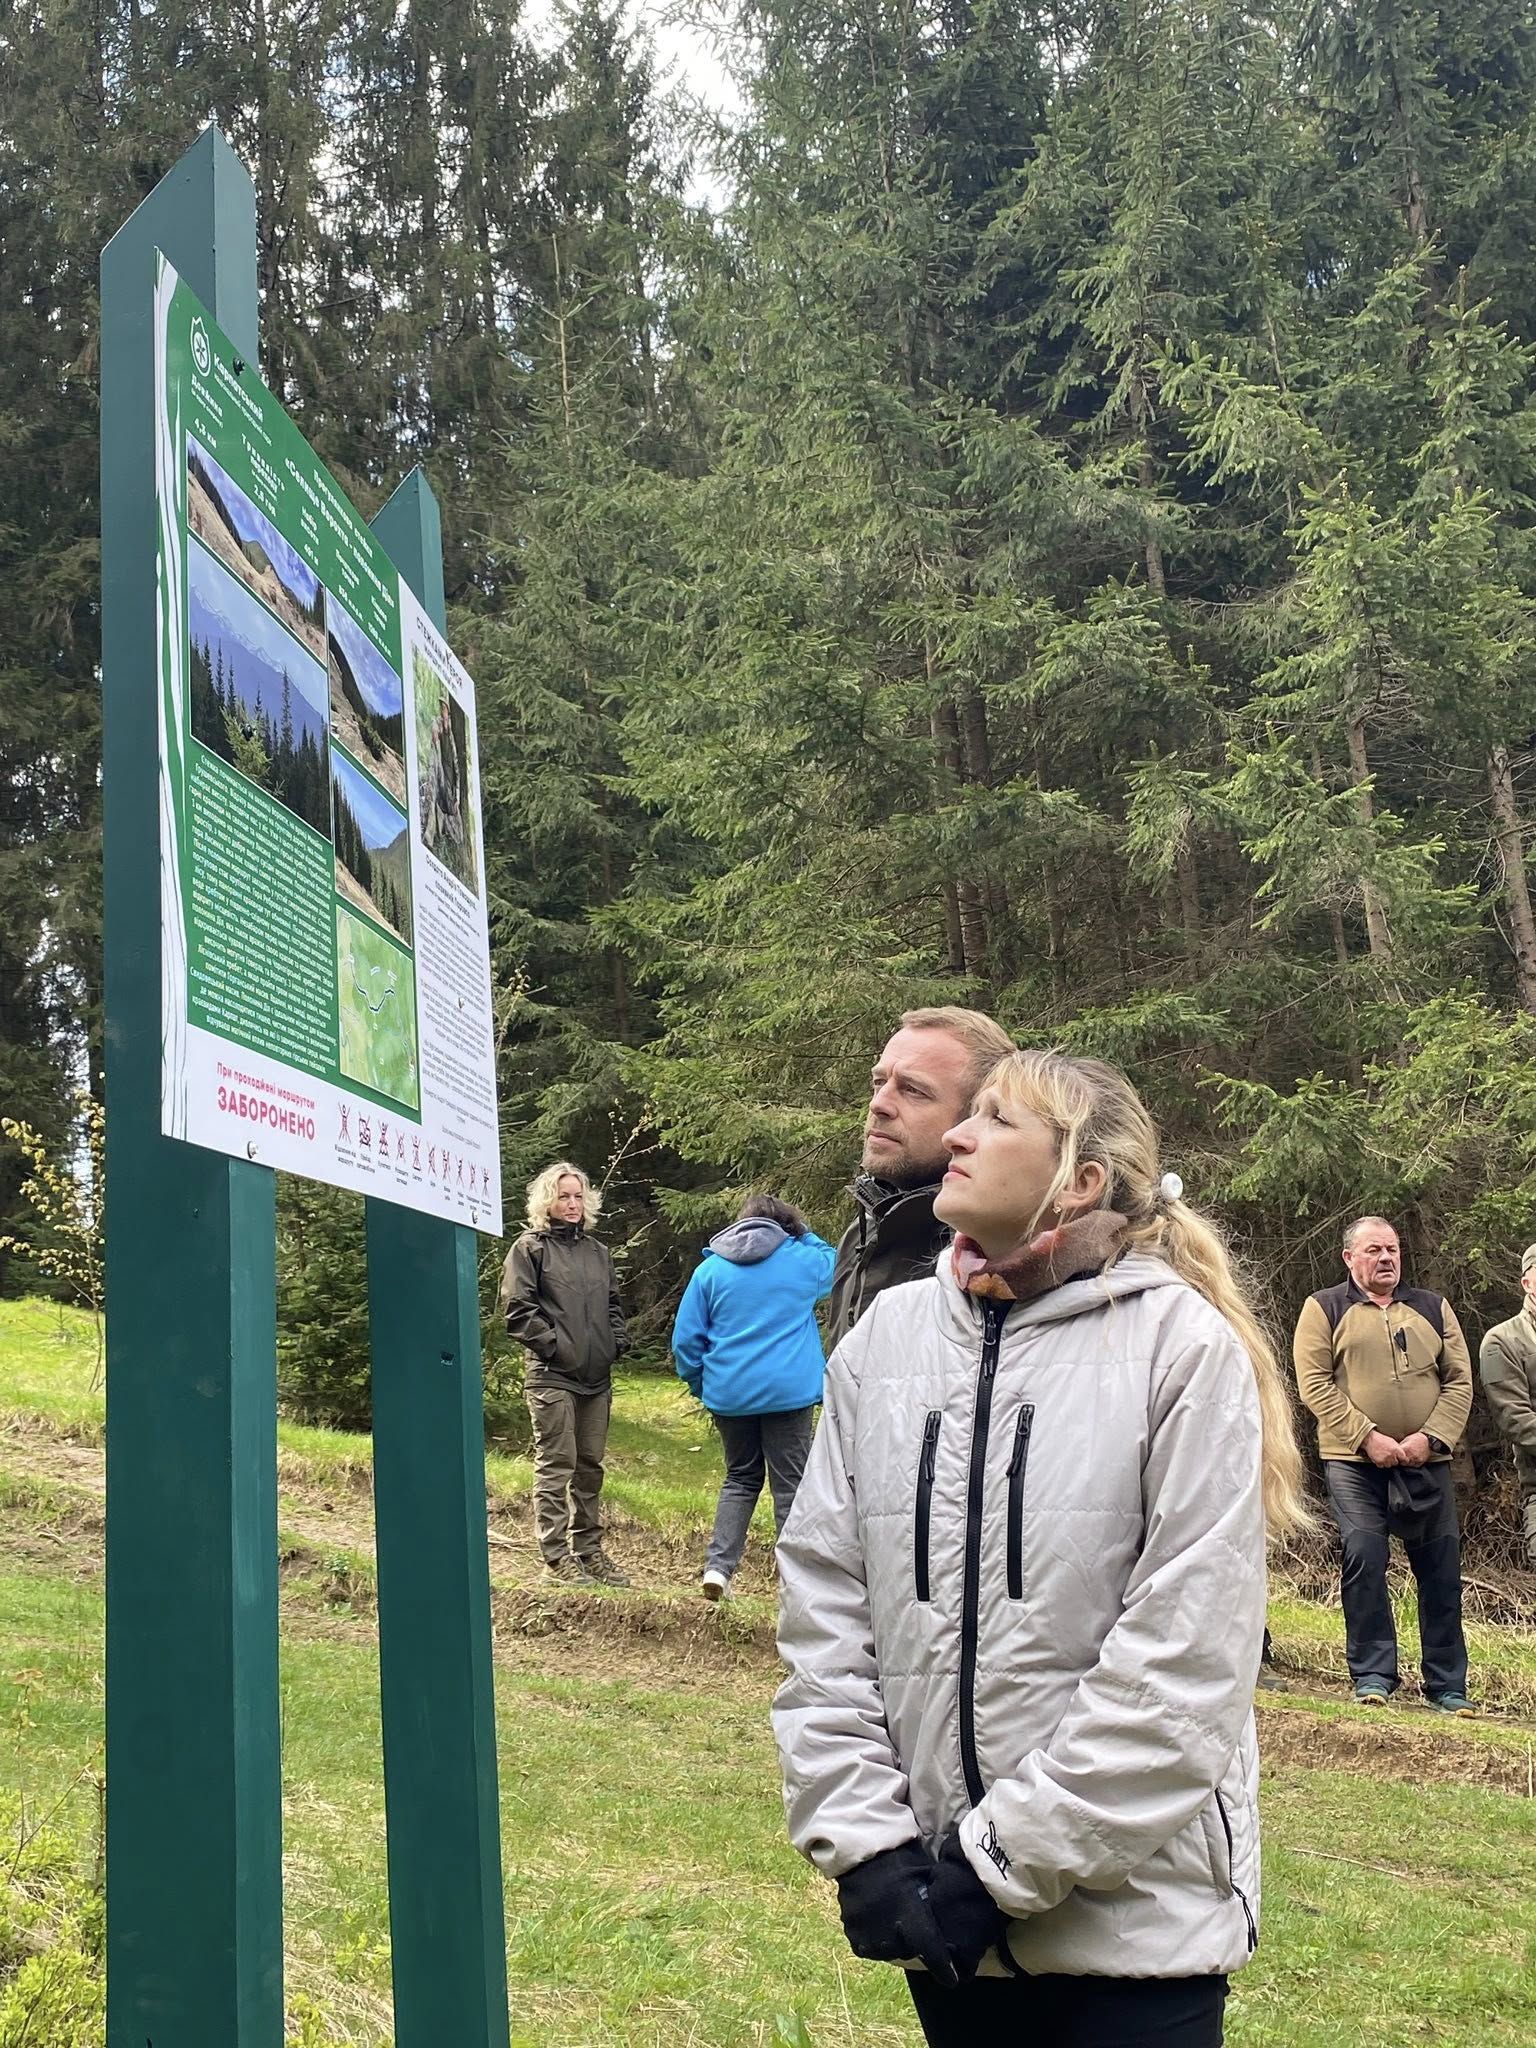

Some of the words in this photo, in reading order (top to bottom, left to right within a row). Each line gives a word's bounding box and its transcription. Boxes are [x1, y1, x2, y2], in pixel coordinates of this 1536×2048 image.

[214, 352, 263, 422] Карпатський
[217, 1062, 232, 1079] При
[278, 1088, 315, 1110] маршрутом
[218, 1086, 314, 1140] ЗАБОРОНЕНО
